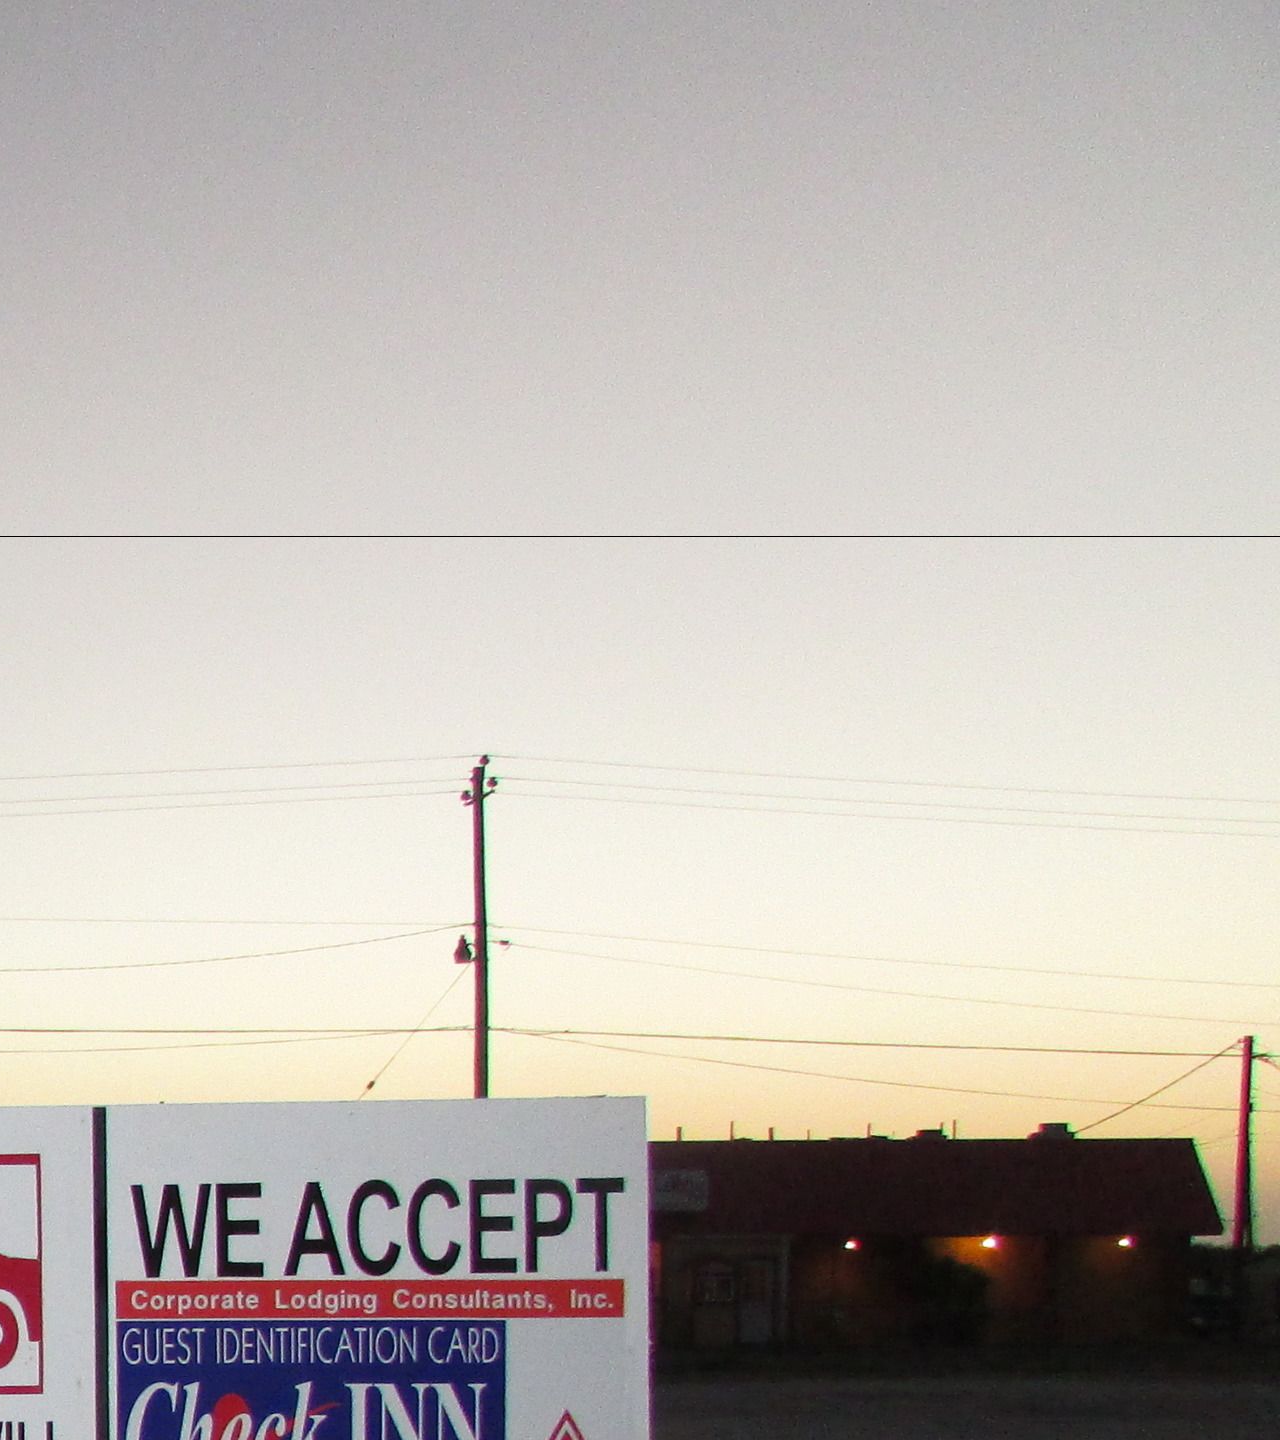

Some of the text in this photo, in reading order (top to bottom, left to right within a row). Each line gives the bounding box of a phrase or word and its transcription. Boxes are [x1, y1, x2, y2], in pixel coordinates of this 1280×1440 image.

[131, 1182, 264, 1278] WE
[284, 1177, 624, 1277] ACCEPT
[131, 1288, 615, 1314] Corporate Lodging Consultants, Inc.
[122, 1326, 499, 1366] GUEST IDENTIFICATION CARD
